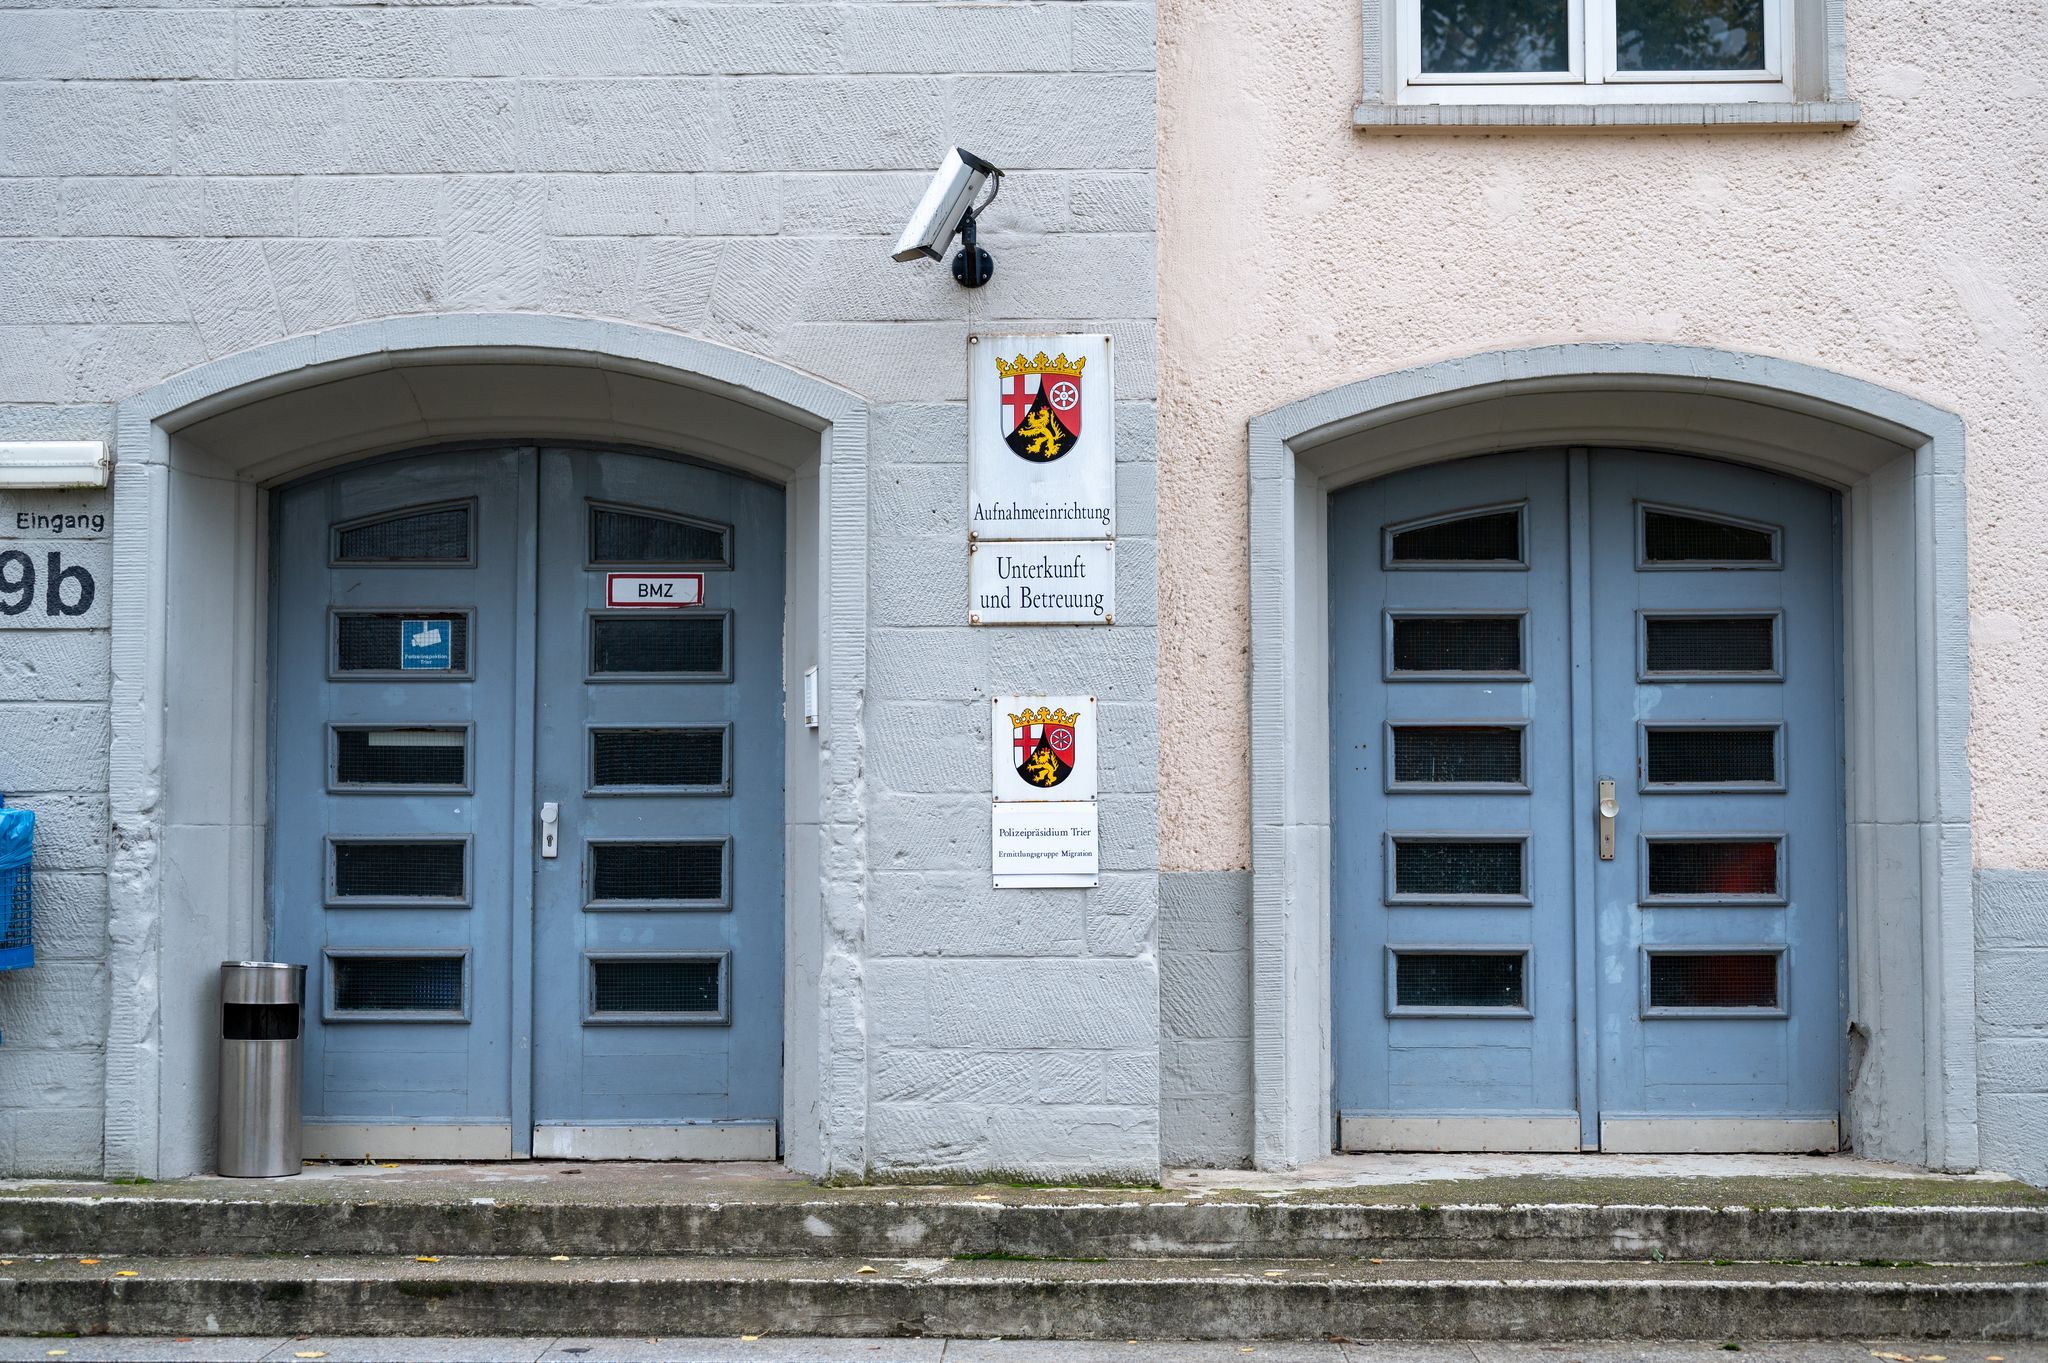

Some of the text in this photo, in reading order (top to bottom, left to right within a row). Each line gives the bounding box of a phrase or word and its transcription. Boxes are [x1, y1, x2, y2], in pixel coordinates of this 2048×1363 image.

[16, 512, 105, 533] Eingang
[974, 502, 1111, 526] Aufnahmeeinrichtung
[996, 555, 1086, 579] Unterkunft
[0, 550, 95, 616] 9b
[638, 583, 674, 598] BMZ
[980, 586, 1104, 616] und Betreuung
[999, 827, 1092, 839] Polizeipräsidium Trier
[998, 850, 1093, 860] Ermittlungsgruppe Migration
